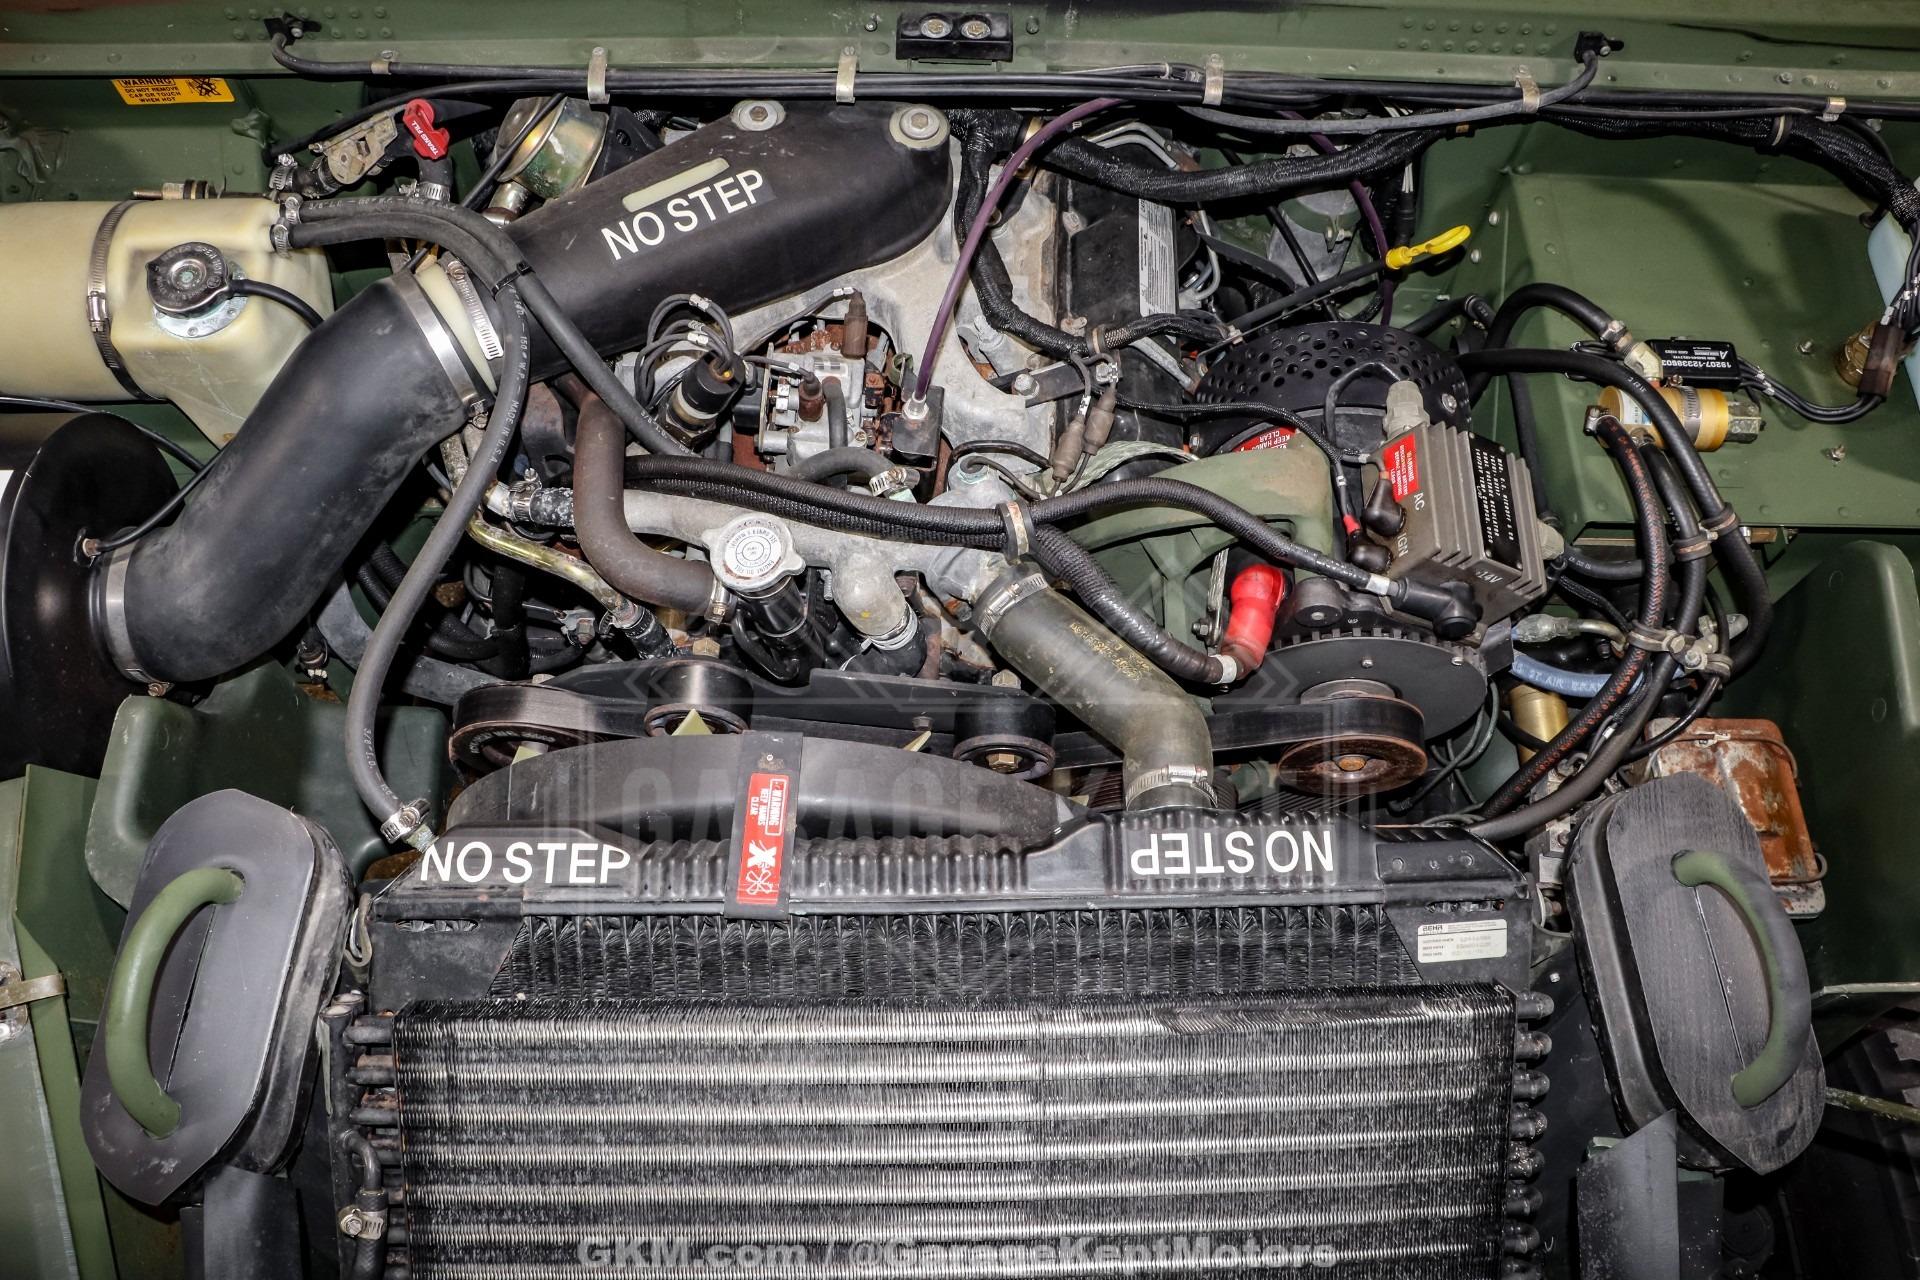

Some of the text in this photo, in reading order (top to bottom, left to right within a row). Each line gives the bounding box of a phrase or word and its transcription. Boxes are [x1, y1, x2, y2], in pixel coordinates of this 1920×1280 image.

[411, 120, 439, 156] TRANS FILL
[601, 169, 764, 261] NO STEP
[505, 399, 520, 425] MADE
[500, 426, 511, 440] IN
[1260, 430, 1280, 443] CLEAR
[1274, 434, 1291, 446] KEEP
[1479, 476, 1487, 494] TEMP
[1413, 492, 1425, 512] AC
[1486, 470, 1494, 498] VOLTAGE
[1490, 500, 1500, 537] REGULATOR
[1397, 532, 1409, 558] IGN
[768, 790, 783, 827] WARNING
[420, 841, 631, 884] NO STEP
[1130, 830, 1334, 875] NO STEP
